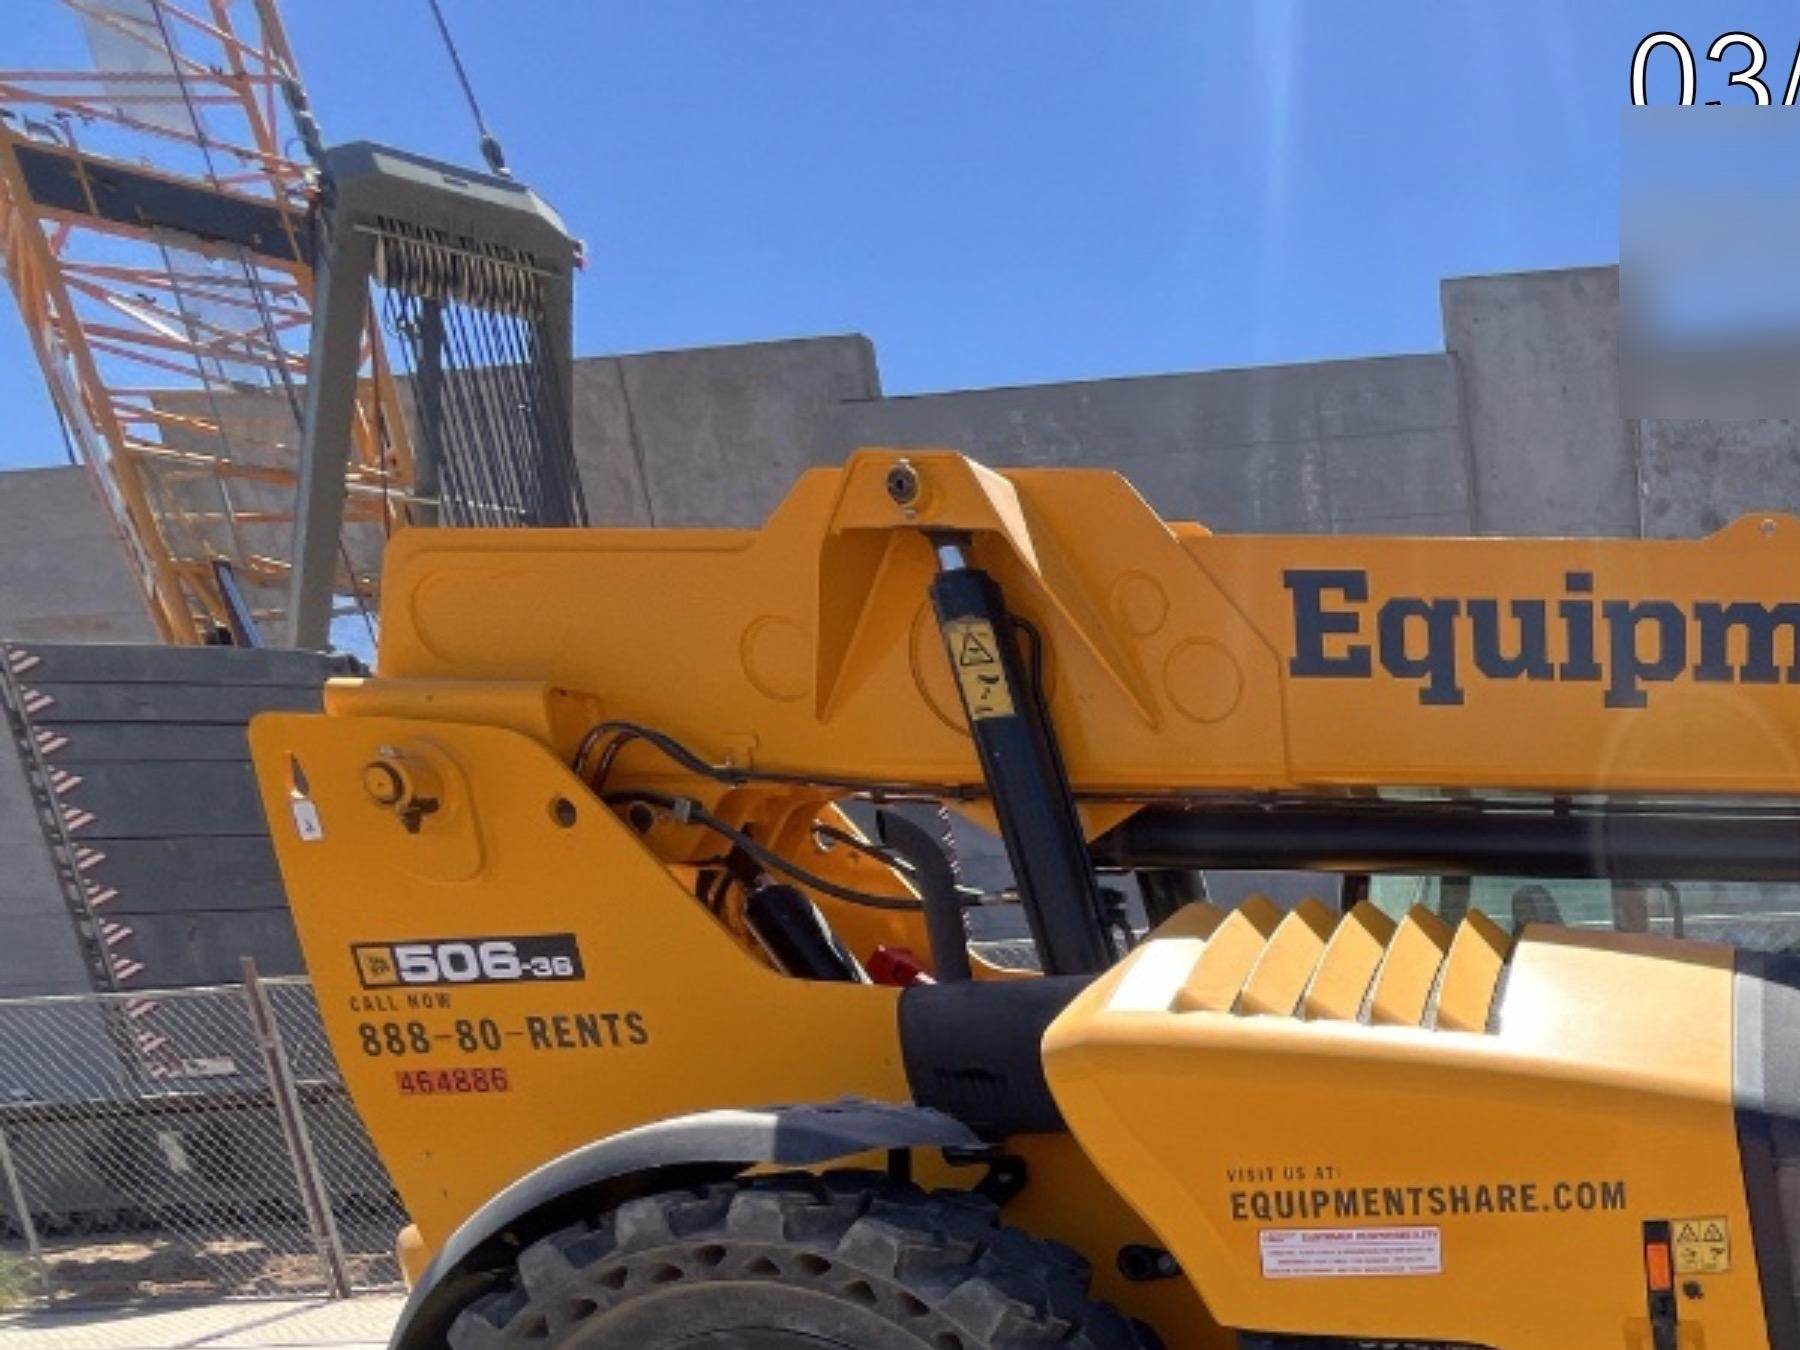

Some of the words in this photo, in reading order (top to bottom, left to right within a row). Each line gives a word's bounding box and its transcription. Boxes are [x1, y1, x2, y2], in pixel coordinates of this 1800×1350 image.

[350, 994, 399, 1012] CALL
[406, 991, 452, 1009] NOW
[358, 1011, 650, 1056] 888-80-RENTS
[400, 1067, 509, 1095] 464886
[1226, 1166, 1273, 1183] VISIT
[1284, 1166, 1306, 1180] US
[1230, 1181, 1628, 1222] EQUIPMENTSHARE.COM
